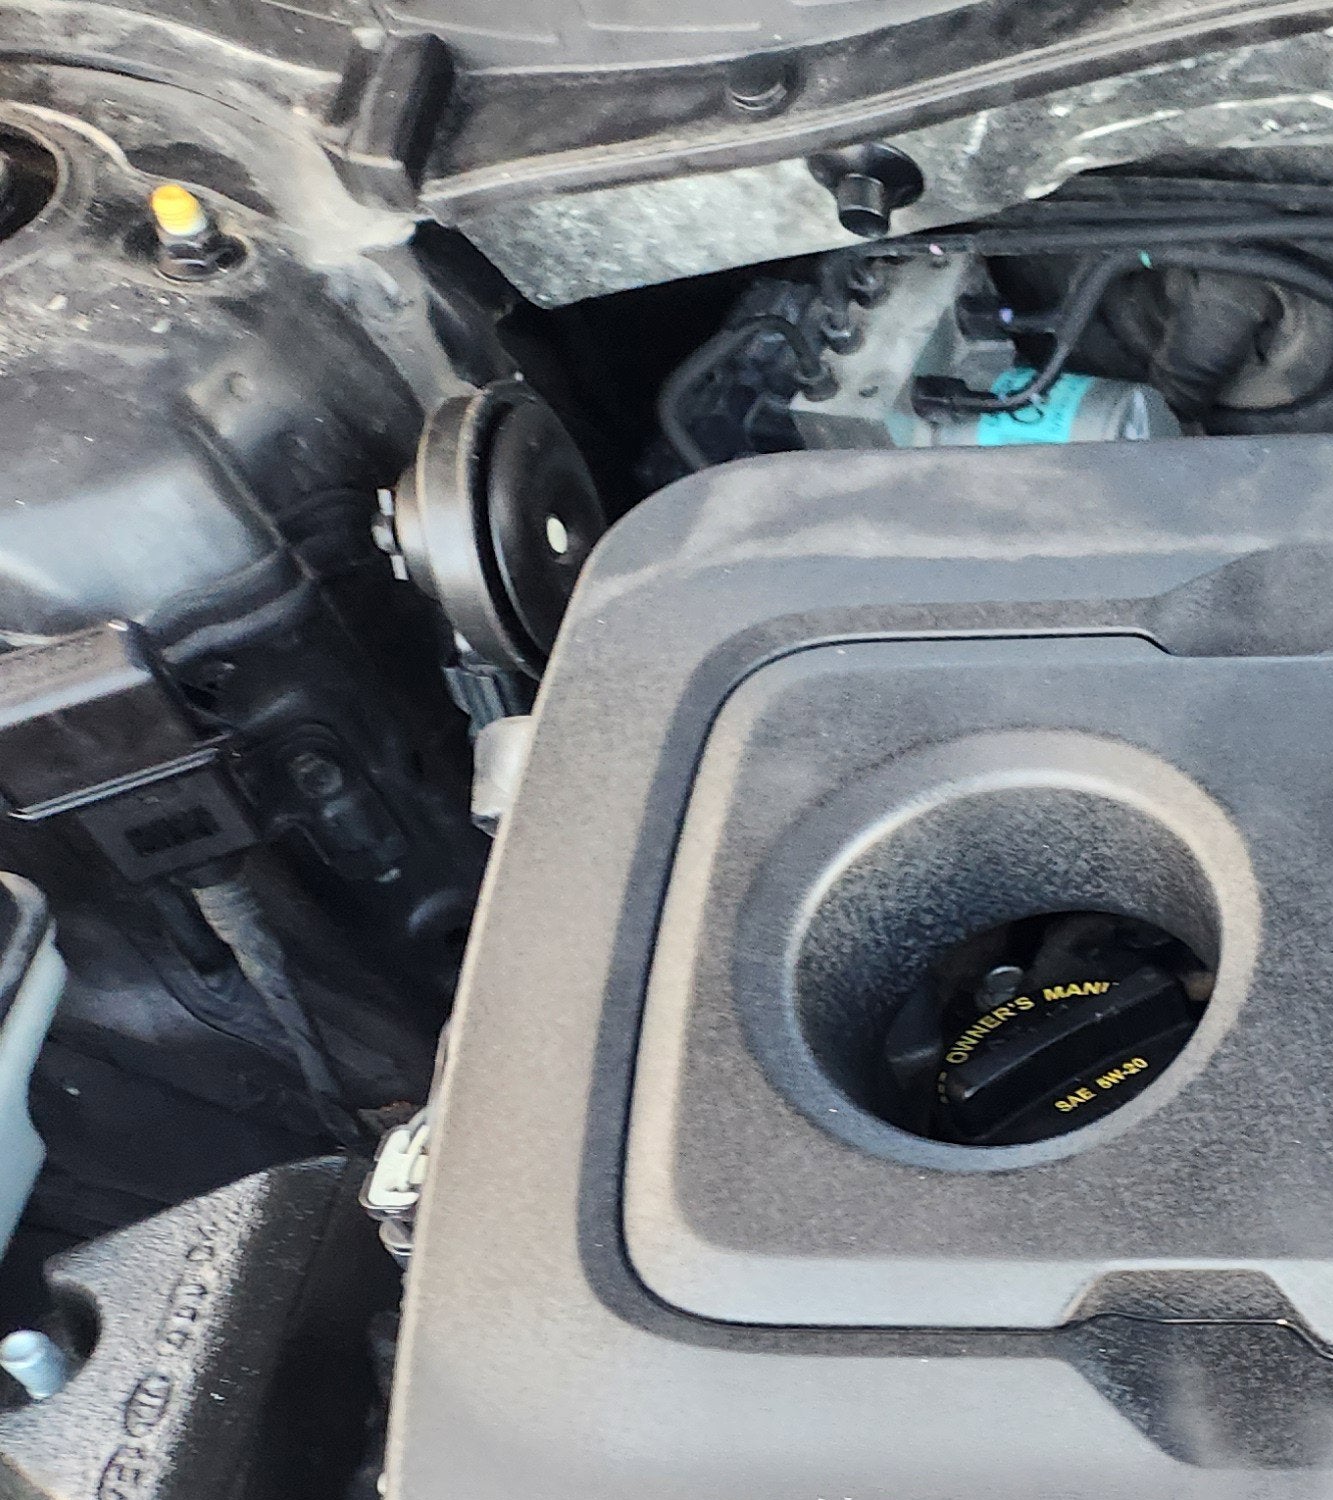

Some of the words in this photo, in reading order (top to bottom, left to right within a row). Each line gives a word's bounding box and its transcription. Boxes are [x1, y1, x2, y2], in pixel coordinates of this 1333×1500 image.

[945, 996, 1035, 1064] OWNER'S
[1042, 981, 1120, 1001] MAN
[1054, 1086, 1098, 1112] SAE
[1095, 1057, 1149, 1089] 5W-20
